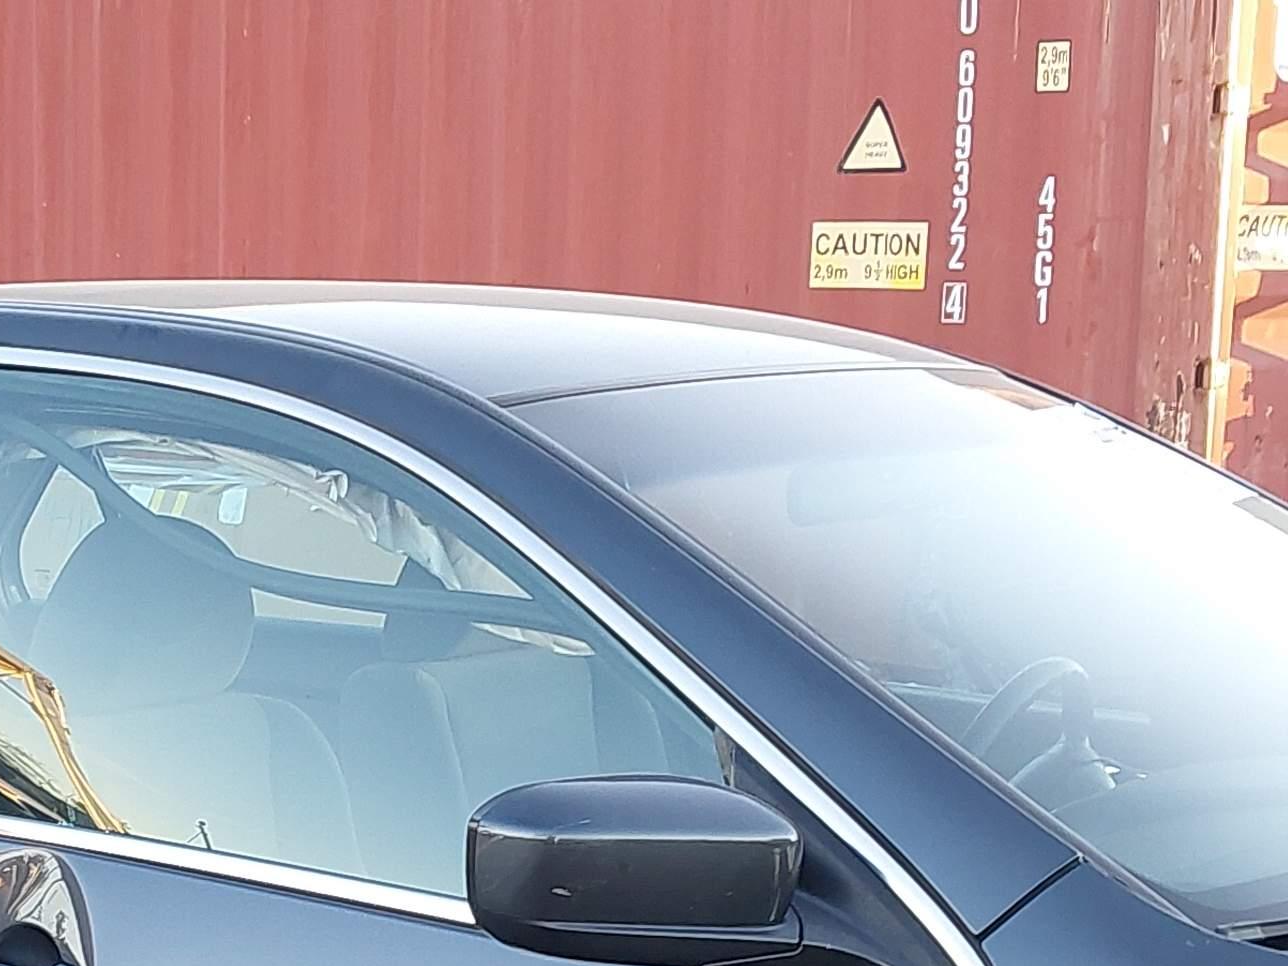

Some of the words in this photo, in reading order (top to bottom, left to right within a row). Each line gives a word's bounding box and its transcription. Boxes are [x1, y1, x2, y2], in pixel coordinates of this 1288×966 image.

[948, 49, 976, 271] 609322
[815, 232, 921, 256] CAUTION
[1034, 175, 1056, 325] 45G1
[885, 264, 920, 280] HIGH
[944, 284, 963, 321] 4
